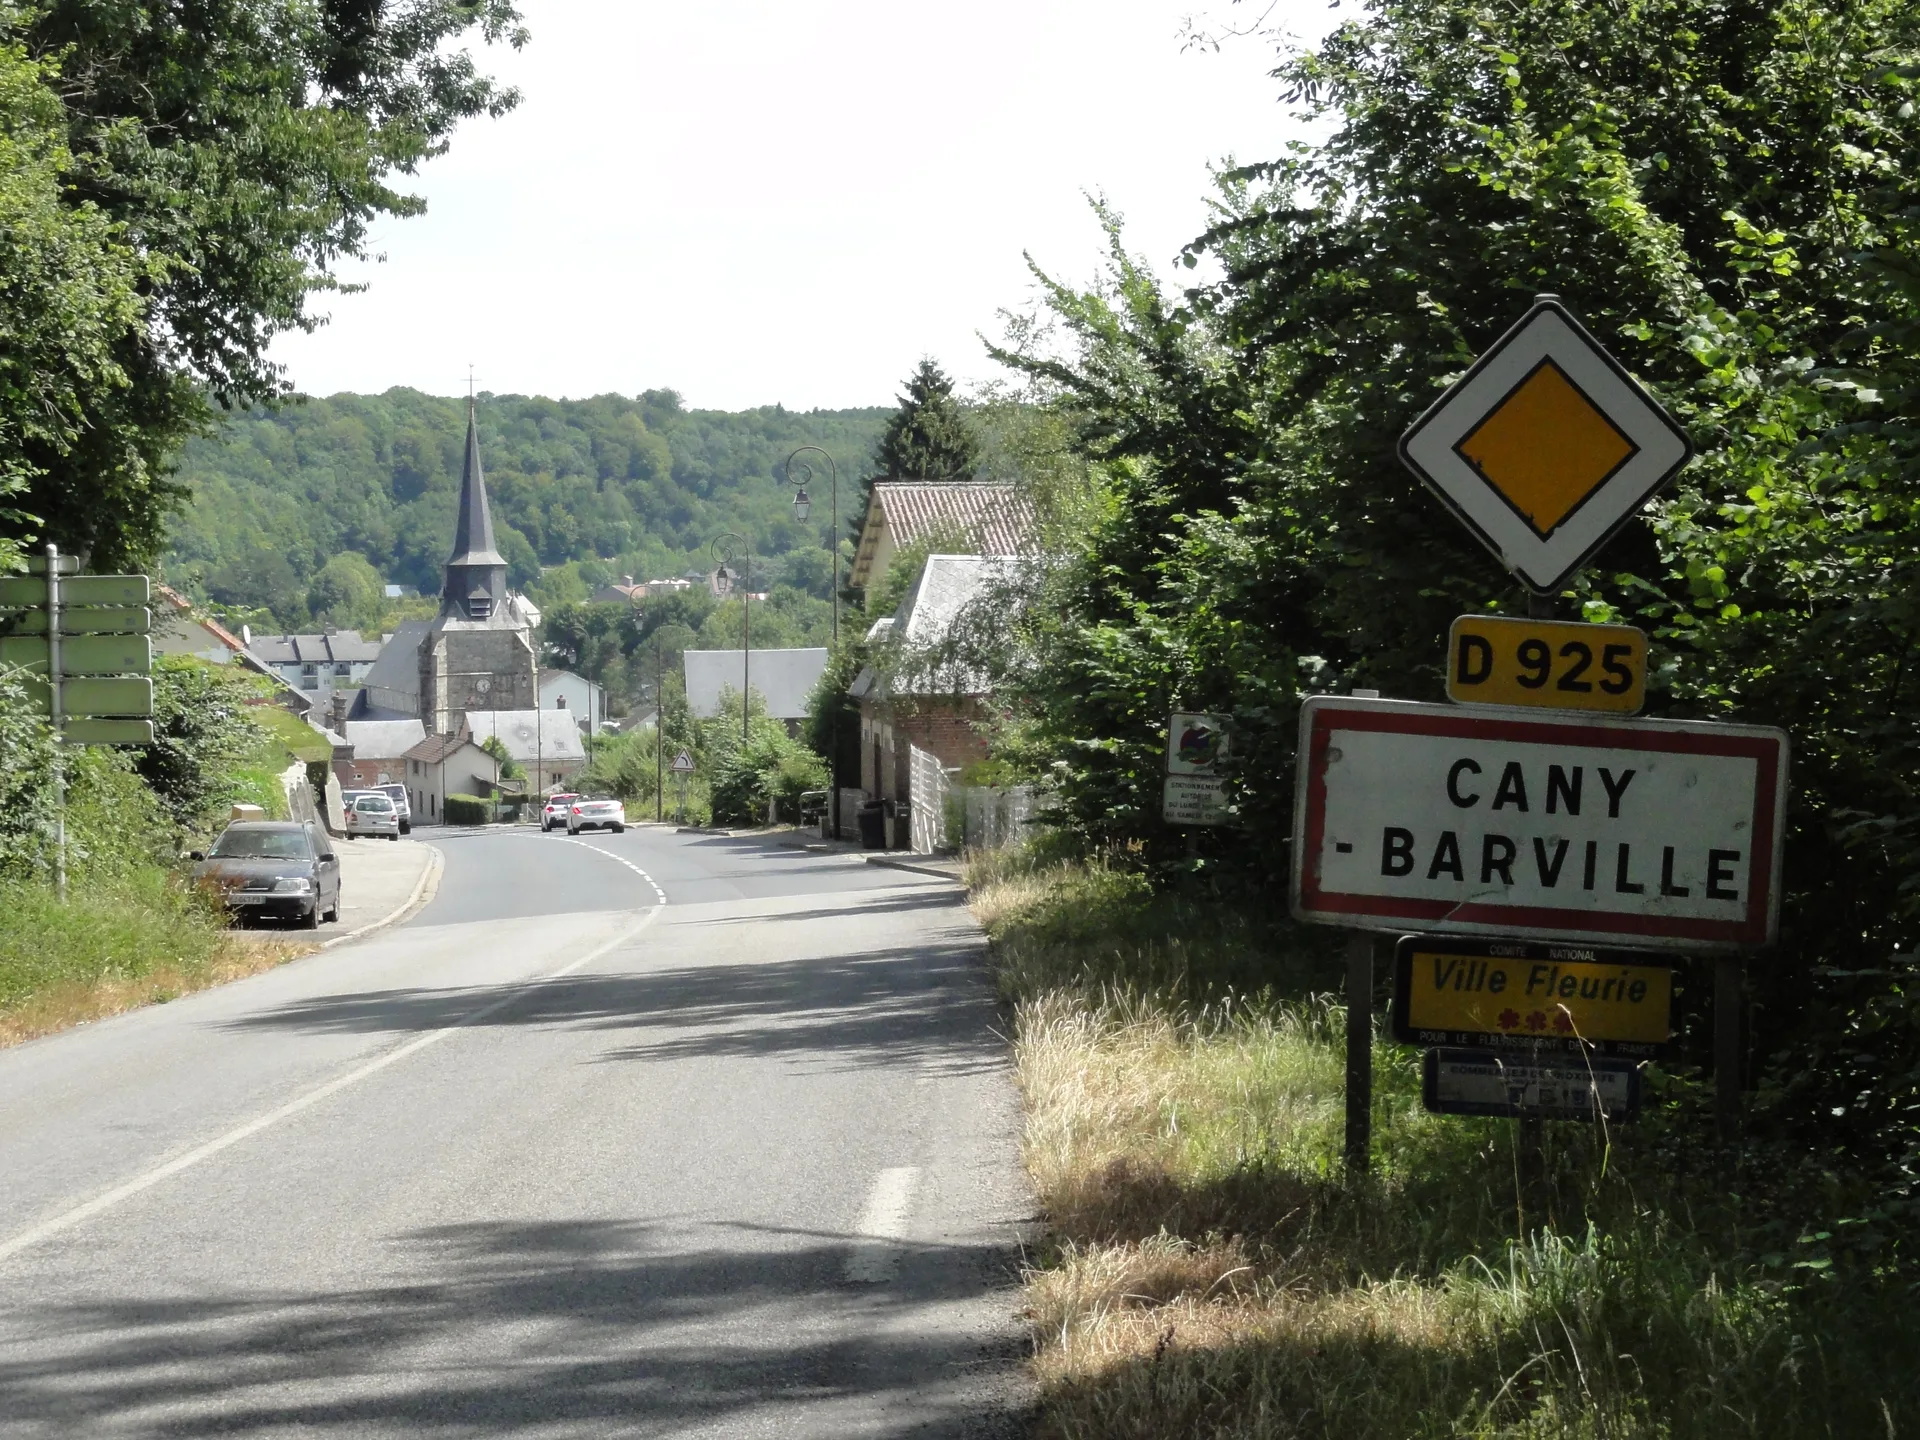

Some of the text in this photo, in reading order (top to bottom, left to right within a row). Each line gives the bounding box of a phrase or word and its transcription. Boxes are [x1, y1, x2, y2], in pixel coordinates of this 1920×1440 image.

[1457, 634, 1634, 695] D 925
[1447, 757, 1637, 819] CANY
[1380, 826, 1741, 900] BARVILLE
[1434, 957, 1648, 1003] Ville Fleurie
[1549, 948, 1596, 961] NATIONAL
[1420, 1031, 1447, 1043] POUR
[1456, 1032, 1469, 1044] LE
[1616, 1043, 1655, 1055] FRANCE
